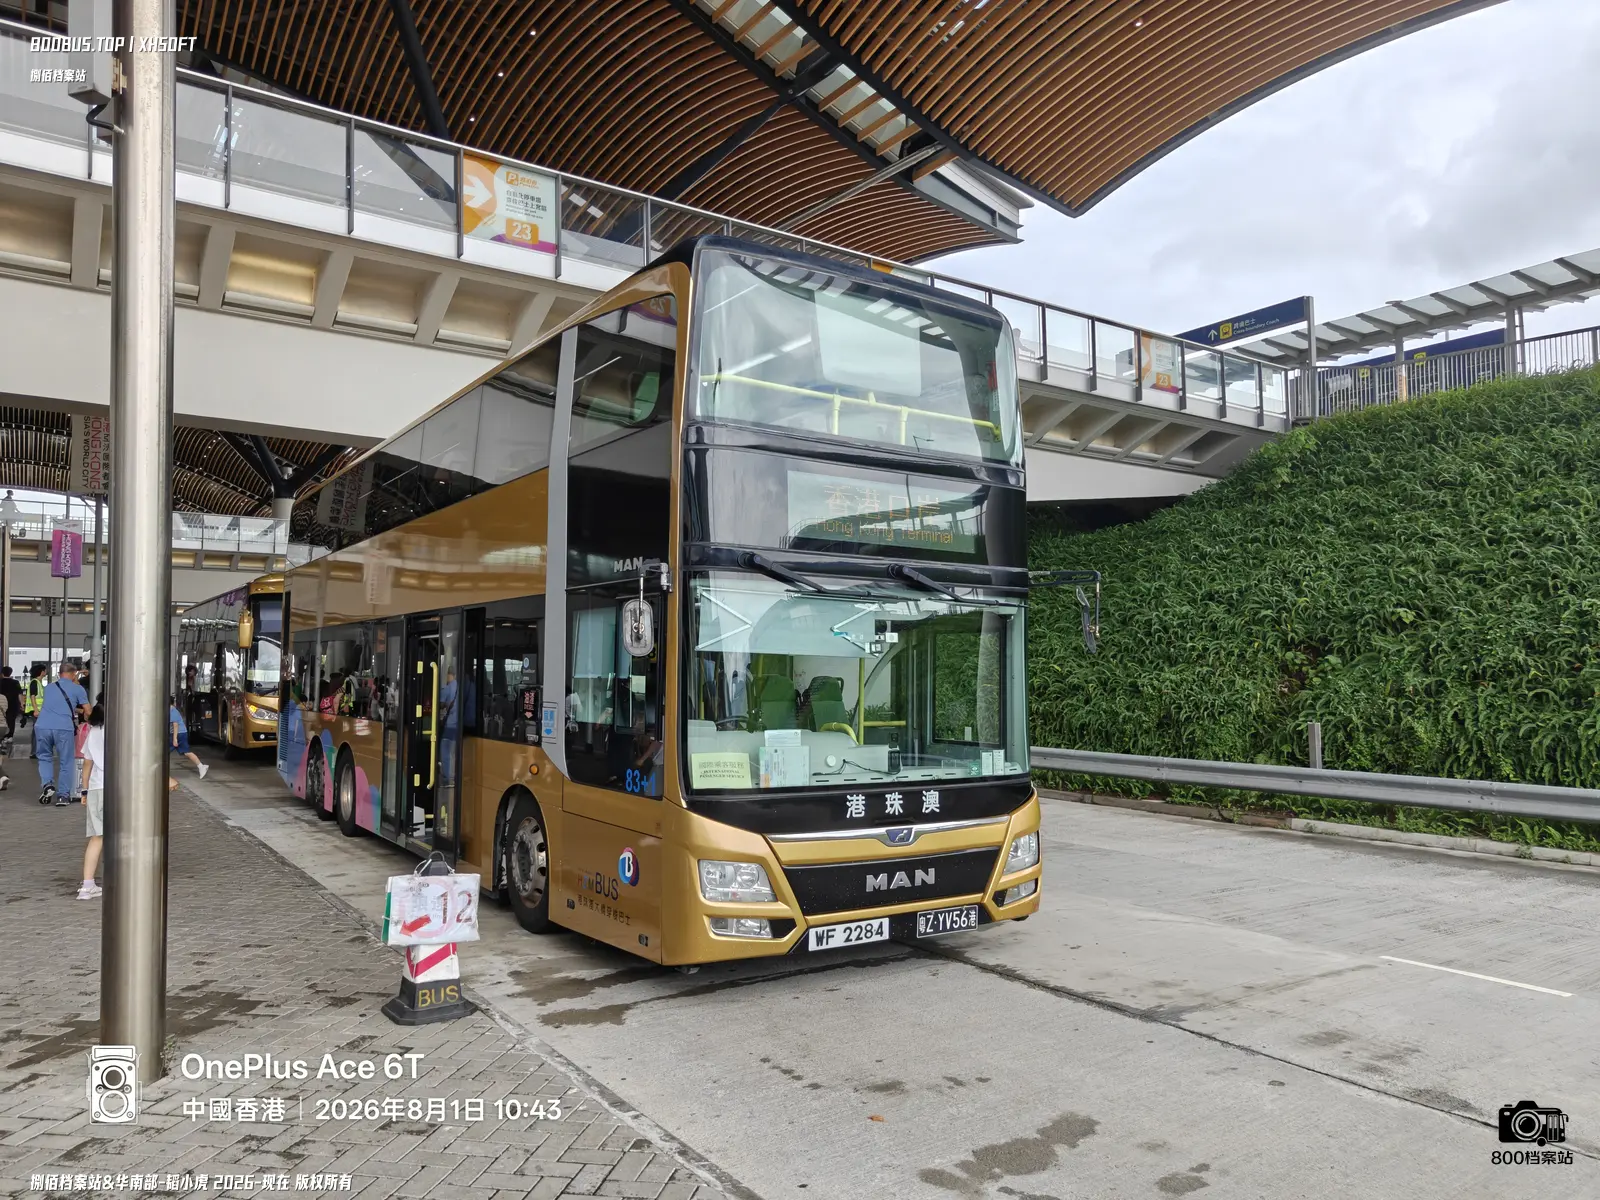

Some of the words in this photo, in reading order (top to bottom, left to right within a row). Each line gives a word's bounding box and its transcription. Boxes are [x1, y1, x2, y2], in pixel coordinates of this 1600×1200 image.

[512, 221, 532, 241] 23
[1158, 374, 1169, 388] 23
[82, 438, 90, 469] WORLD
[81, 469, 90, 489] CITY
[89, 451, 101, 490] KONG
[824, 485, 940, 526] 香港口岸
[613, 557, 643, 573] MAN
[625, 768, 656, 797] 83+1
[865, 867, 936, 893] MAN
[440, 890, 473, 925] 12
[815, 928, 836, 948] WF
[843, 921, 884, 943] 2284
[418, 985, 459, 1008] BUS
